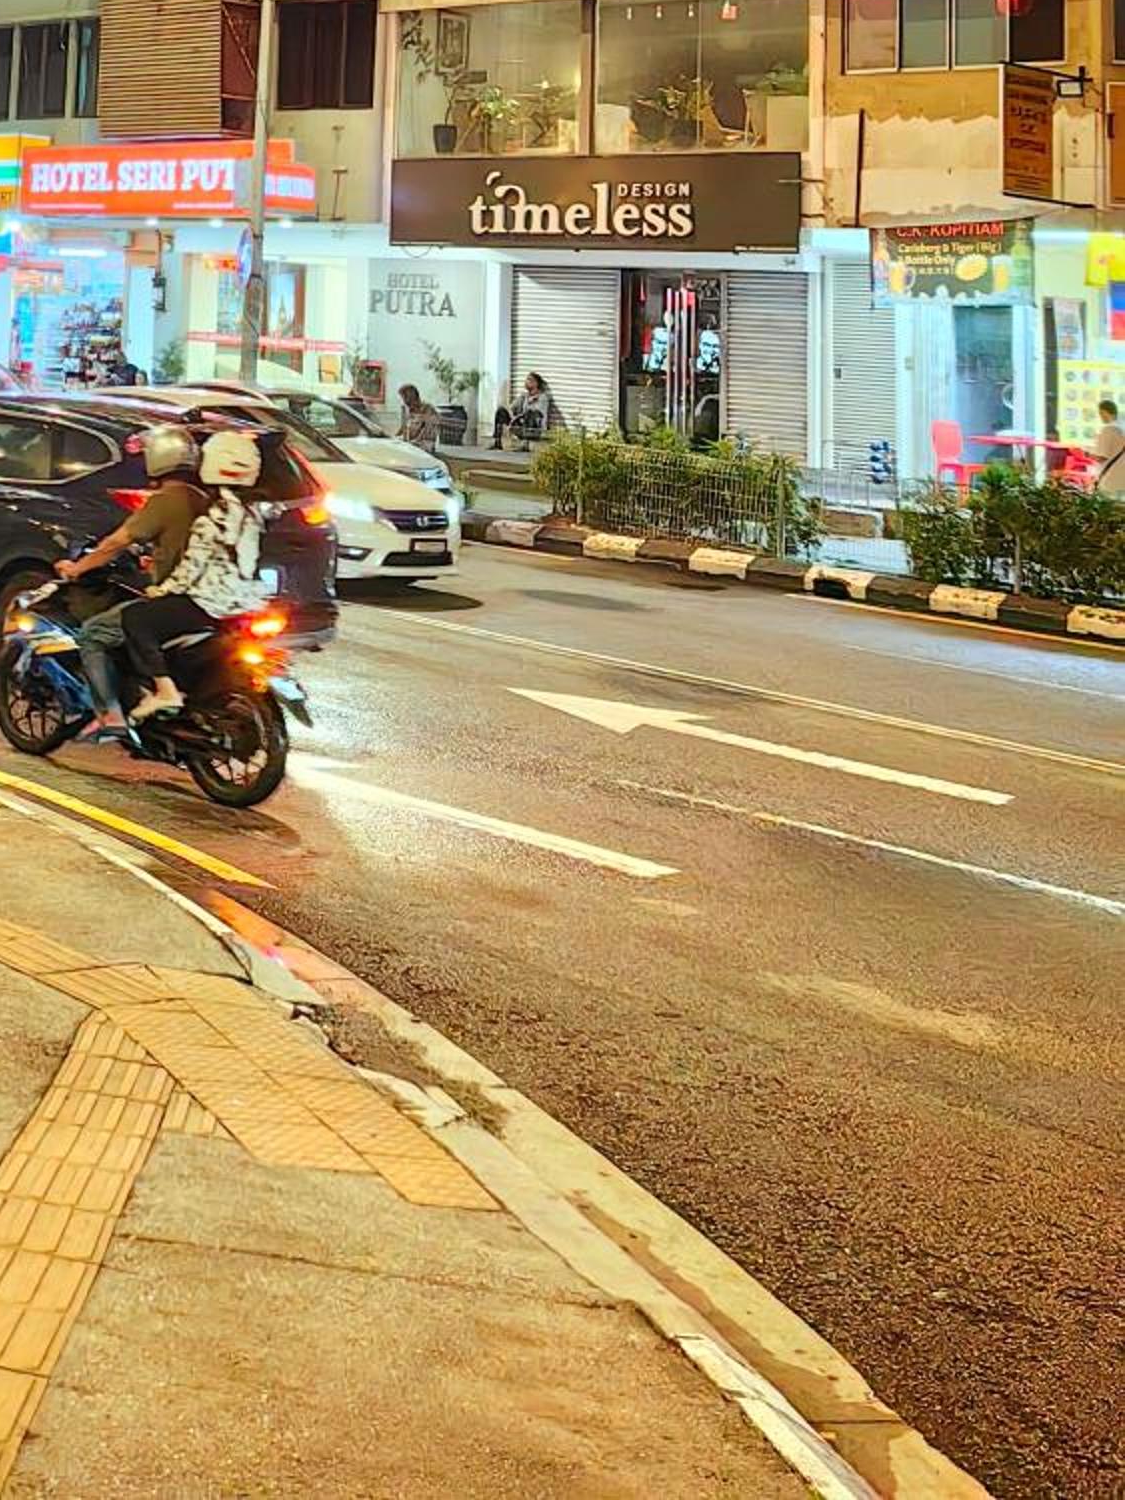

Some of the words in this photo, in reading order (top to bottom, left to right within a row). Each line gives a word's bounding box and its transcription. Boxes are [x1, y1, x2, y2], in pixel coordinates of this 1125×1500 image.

[30, 161, 114, 193] HOTEL
[117, 160, 178, 192] SERI
[617, 182, 692, 198] DESIGN
[468, 171, 695, 238] timeless
[387, 273, 440, 289] HOTEL
[368, 289, 457, 317] PUTRA
